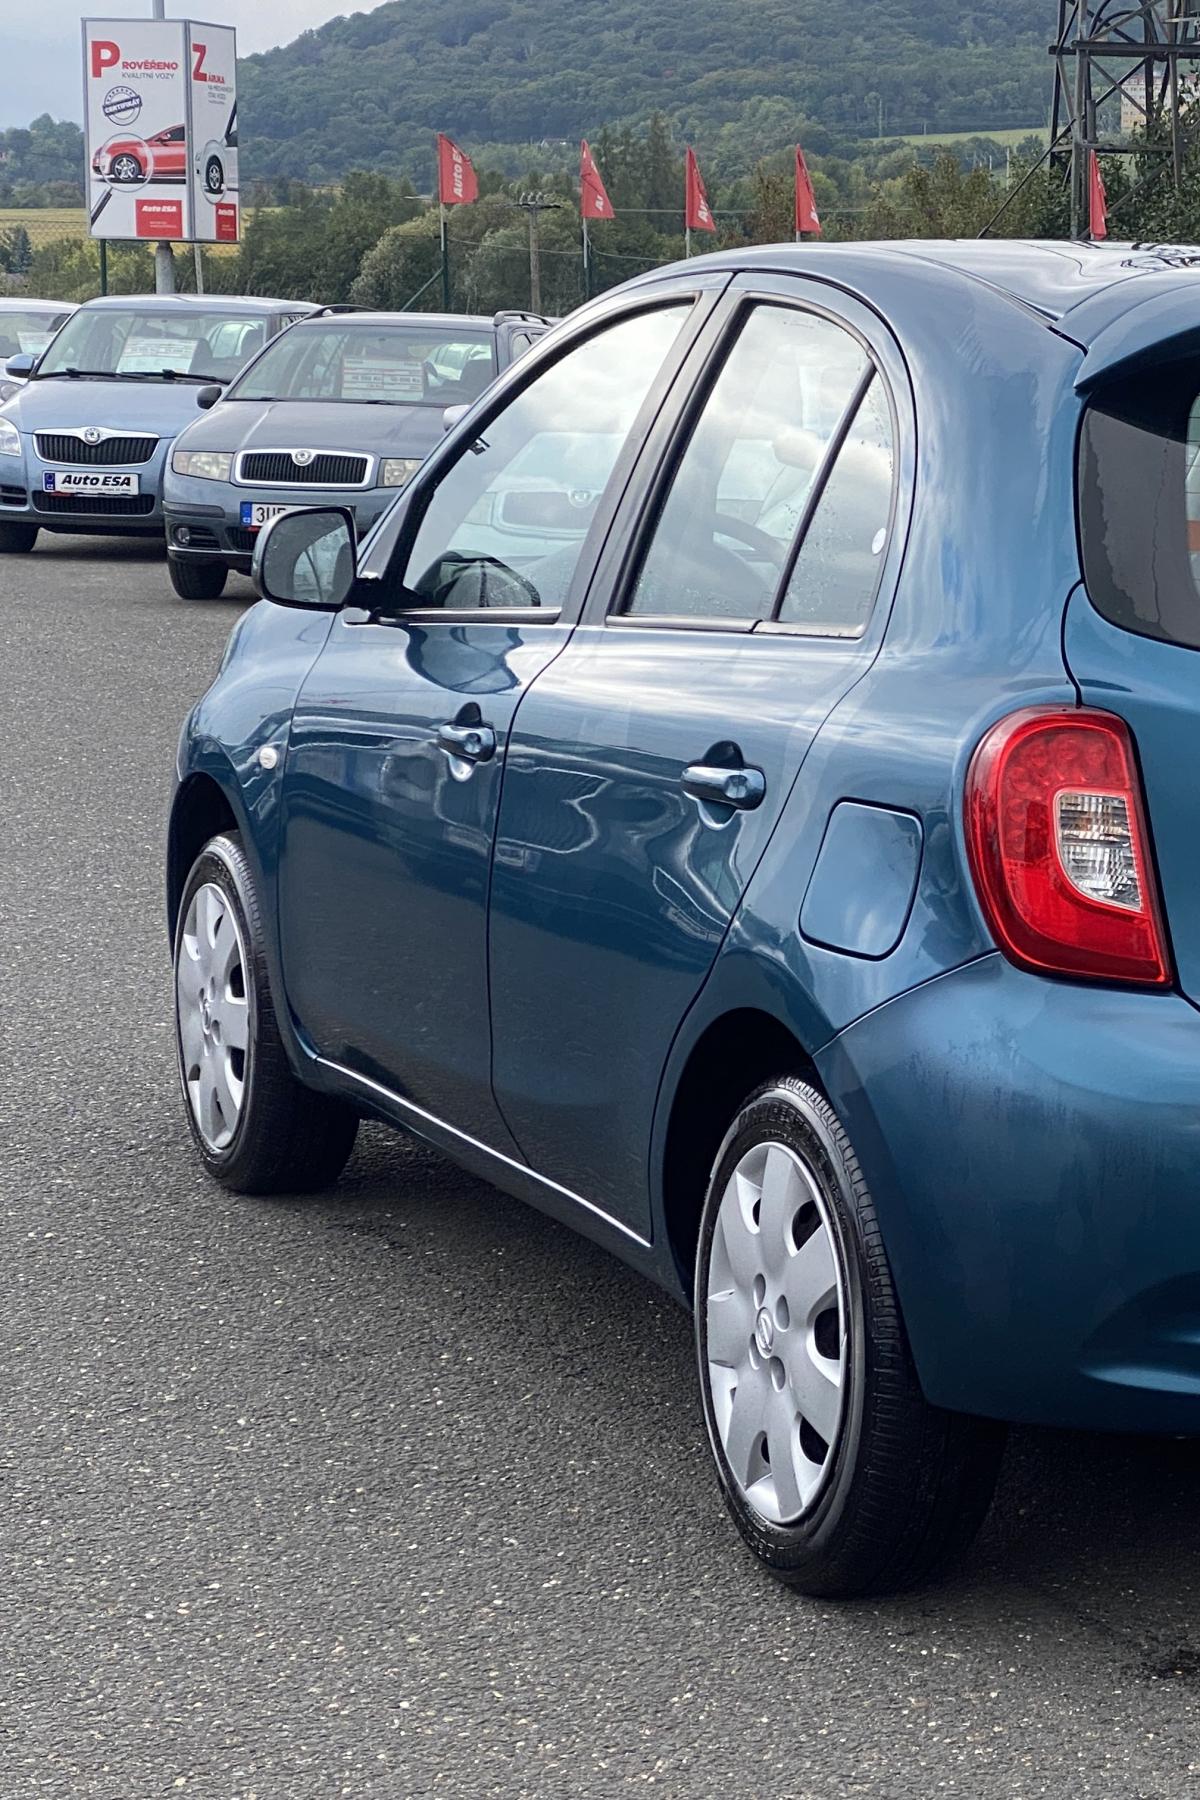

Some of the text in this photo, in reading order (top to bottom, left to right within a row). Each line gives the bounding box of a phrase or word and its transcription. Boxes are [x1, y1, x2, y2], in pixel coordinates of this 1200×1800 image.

[155, 72, 175, 80] VOZY
[453, 163, 463, 198] Auto
[61, 474, 131, 487] Auto ESA
